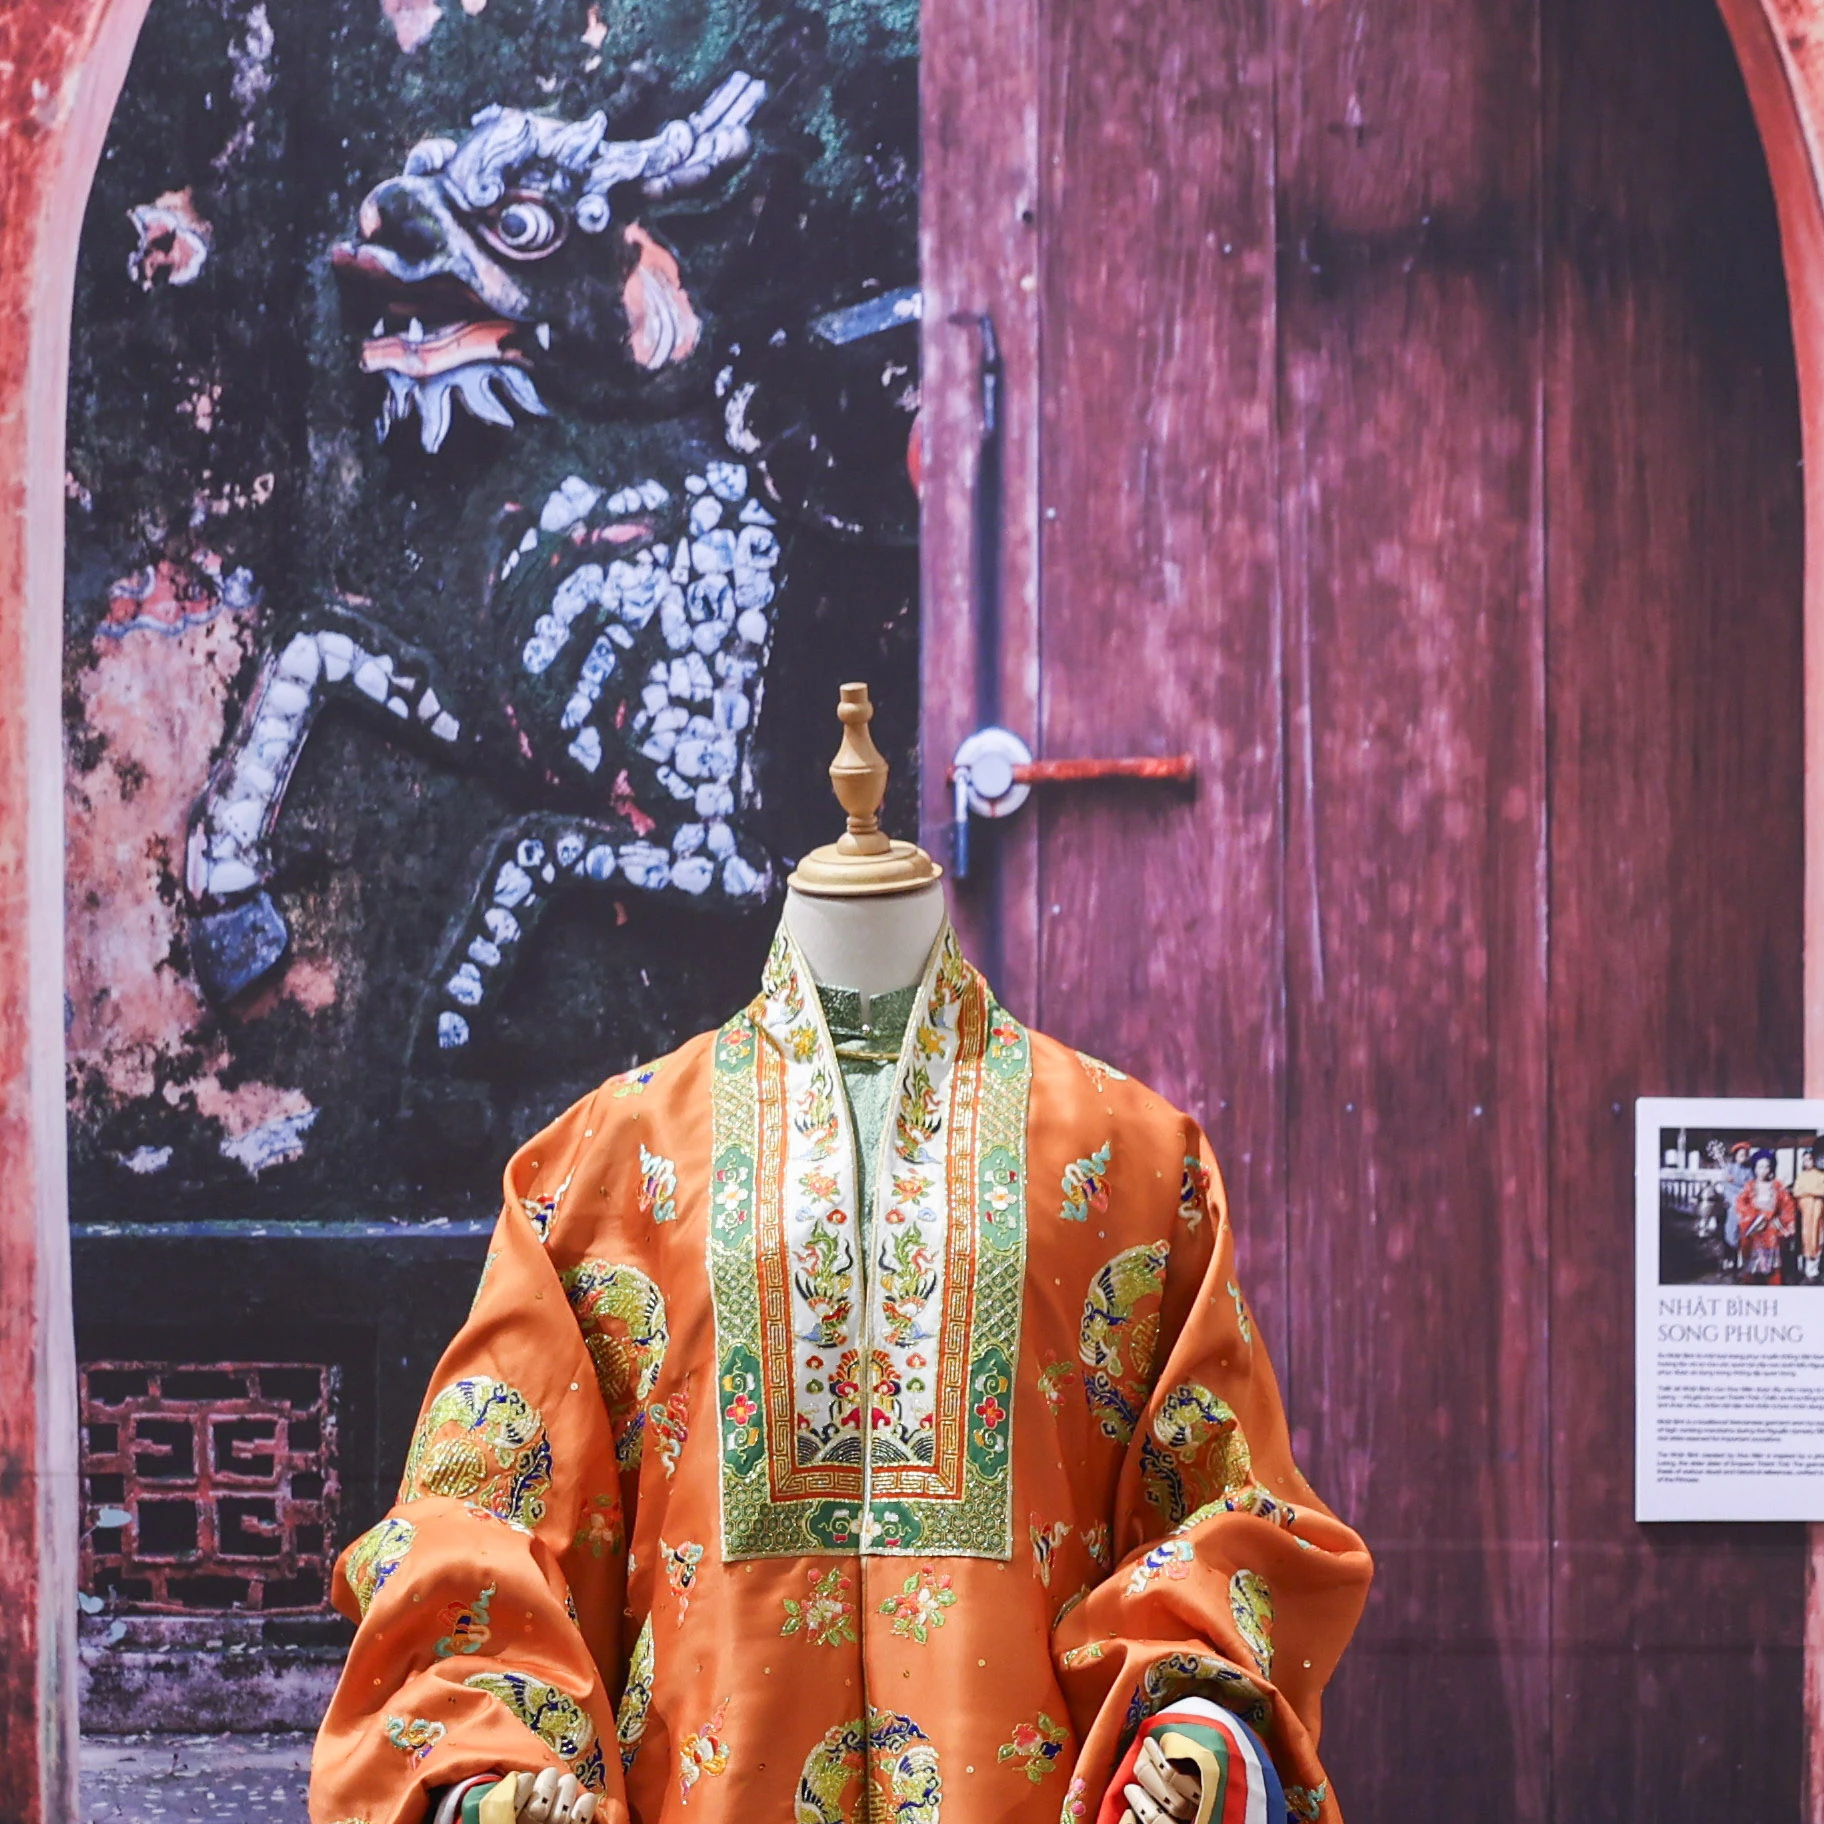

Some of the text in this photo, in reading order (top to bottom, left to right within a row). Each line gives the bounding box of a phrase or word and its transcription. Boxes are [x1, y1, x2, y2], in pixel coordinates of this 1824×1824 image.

[1658, 1294, 1778, 1318] NHẬT BÌNH
[1657, 1323, 1804, 1345] SONG PHỤNG
